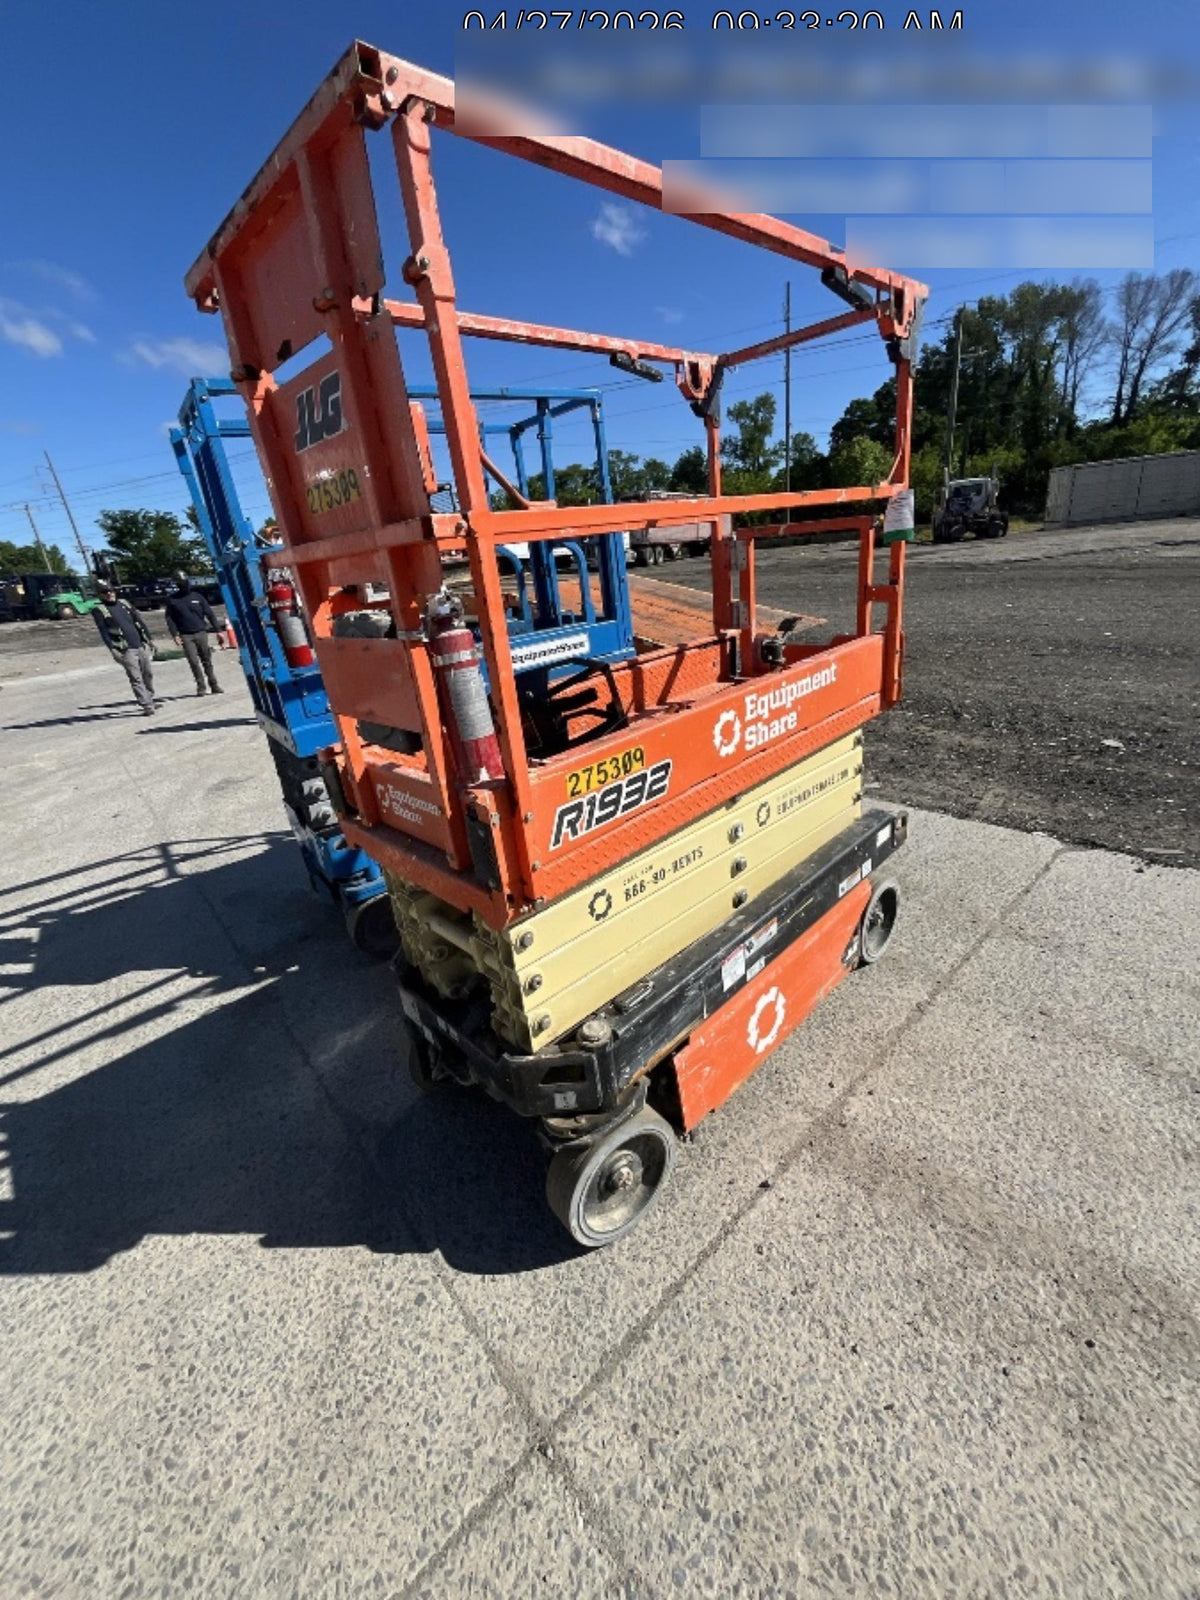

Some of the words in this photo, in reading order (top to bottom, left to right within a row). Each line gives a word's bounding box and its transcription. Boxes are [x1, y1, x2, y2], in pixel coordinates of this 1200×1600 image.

[295, 369, 345, 455] JLG
[306, 468, 361, 514] 275309
[744, 662, 837, 722] Equipment
[744, 710, 798, 751] Share
[567, 747, 645, 797] 275309
[550, 759, 672, 850] R1932
